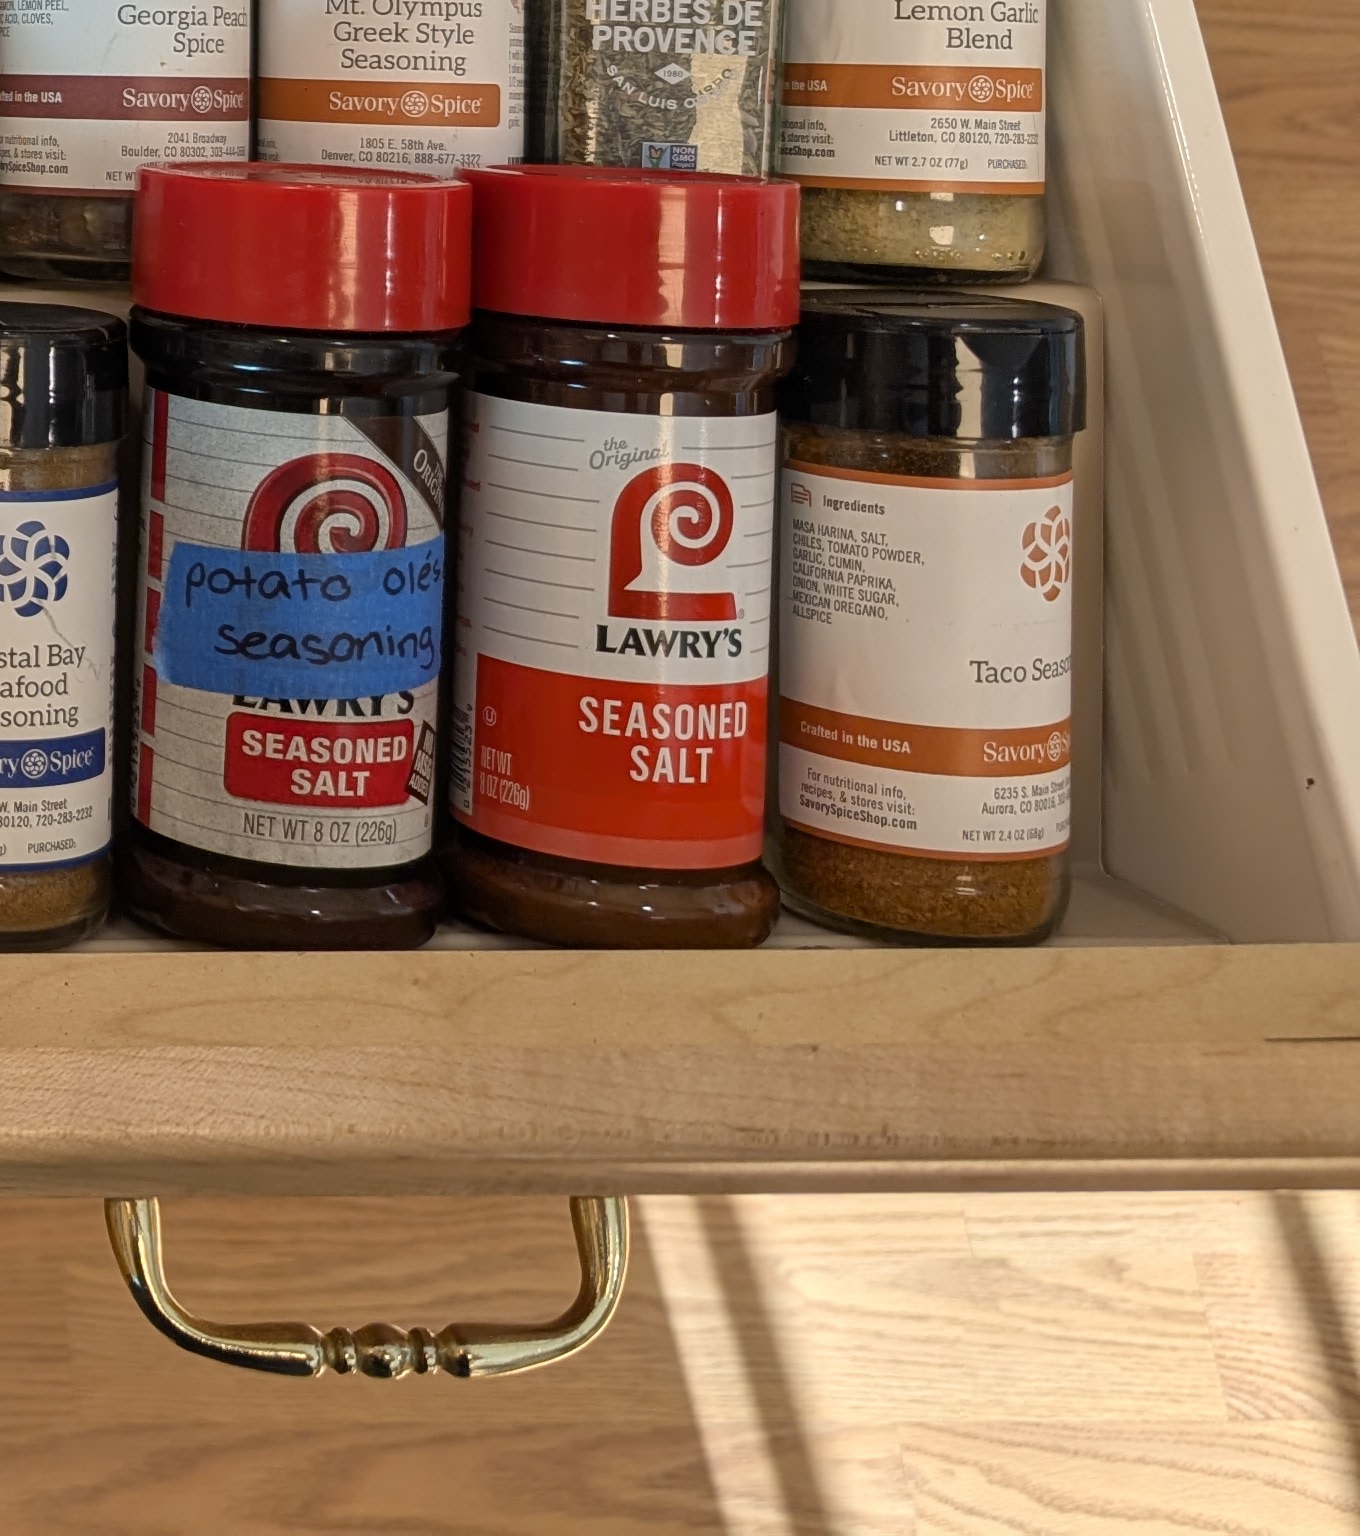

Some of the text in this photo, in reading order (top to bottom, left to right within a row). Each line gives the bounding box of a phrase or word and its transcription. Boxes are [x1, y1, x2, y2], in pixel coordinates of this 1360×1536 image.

[117, 4, 208, 30] Georgia
[722, 0, 764, 28] DE
[893, 0, 1039, 25] Lemon Garlic
[173, 32, 225, 57] Spice
[332, 22, 475, 49] Greek Style
[591, 26, 757, 57] PROVENCE
[945, 28, 1013, 51] Blend
[340, 49, 467, 76] Seasoning
[822, 494, 886, 516] Ingredients
[184, 562, 353, 608] potato
[213, 623, 437, 670] seasoning
[595, 623, 743, 660] LAWRY'S
[46, 644, 87, 671] Bay
[969, 659, 1027, 685] Taco
[578, 695, 749, 741] SEASONED
[241, 729, 408, 765] SEASONED
[800, 720, 911, 754] Crafted in the USA
[629, 744, 713, 784] SALT
[290, 768, 371, 798] SALT
